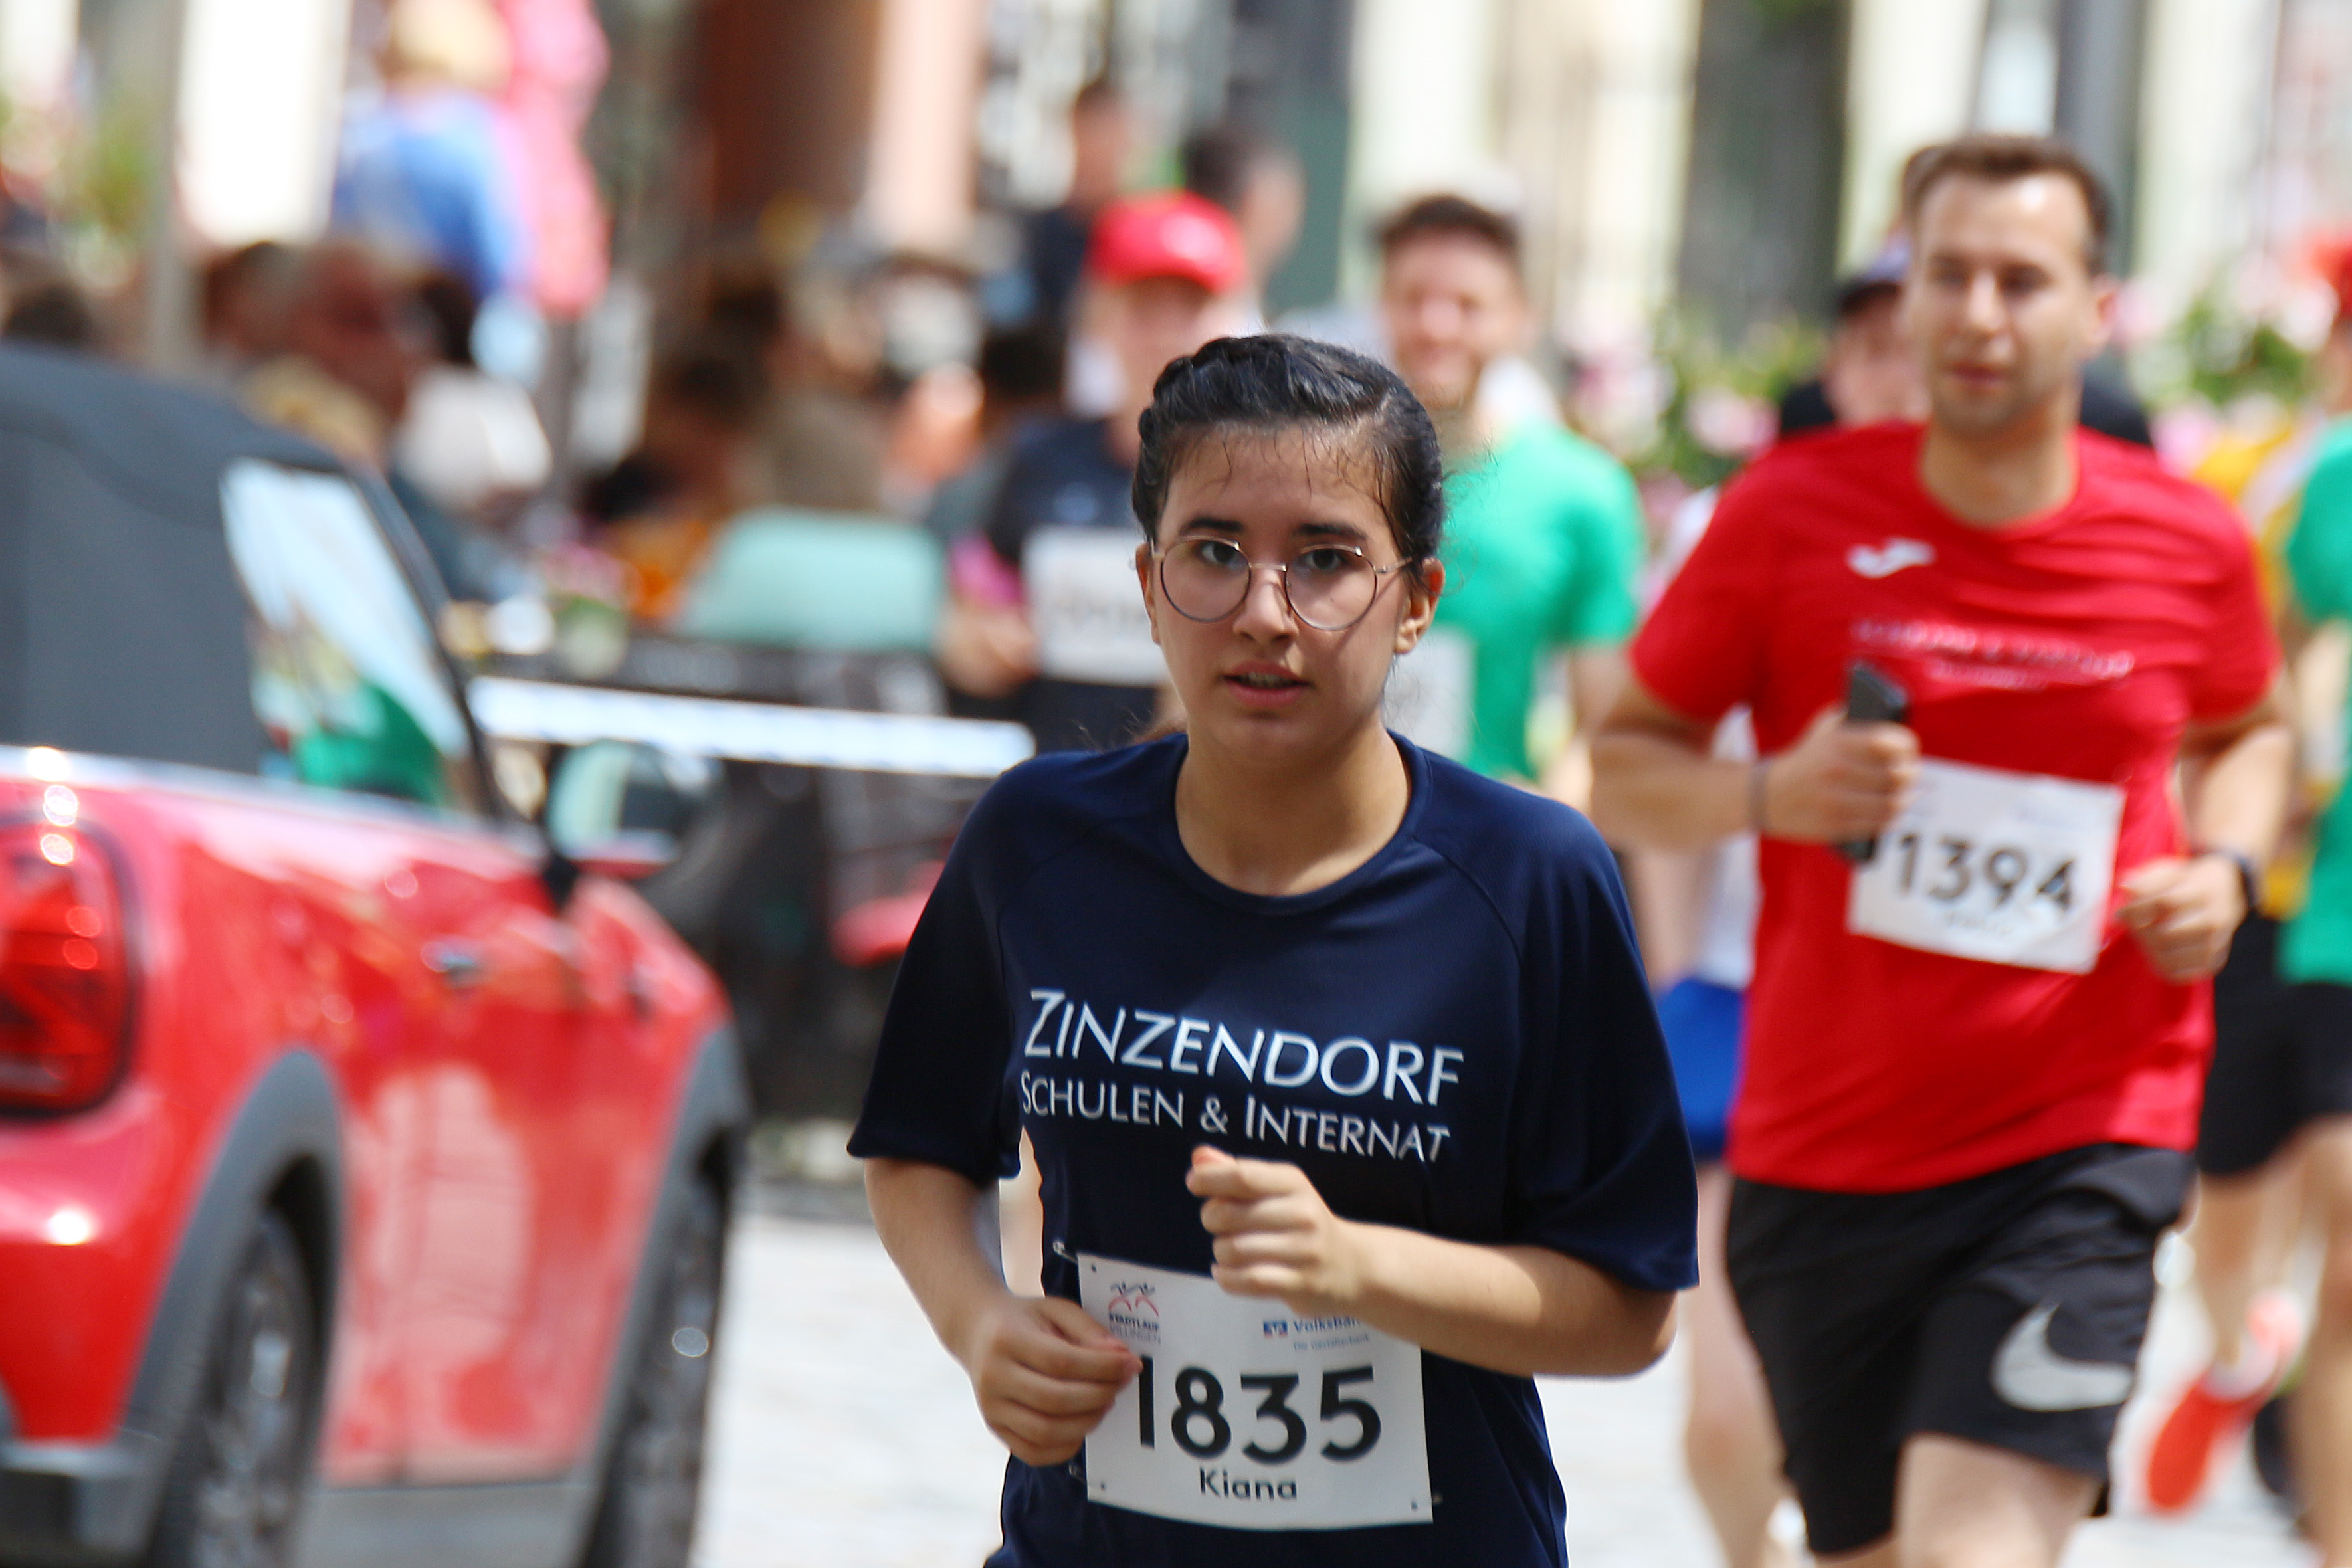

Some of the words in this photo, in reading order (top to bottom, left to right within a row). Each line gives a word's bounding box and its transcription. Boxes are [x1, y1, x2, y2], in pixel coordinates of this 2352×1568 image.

[1897, 834, 2076, 910] 1394
[1024, 989, 1464, 1106] ZINZENDORF
[1021, 1070, 1184, 1127] SCHULEN
[1199, 1095, 1228, 1133] &
[1245, 1094, 1450, 1162] INTERNAT
[1138, 1355, 1381, 1464] 1835
[1199, 1468, 1297, 1500] Kiana
